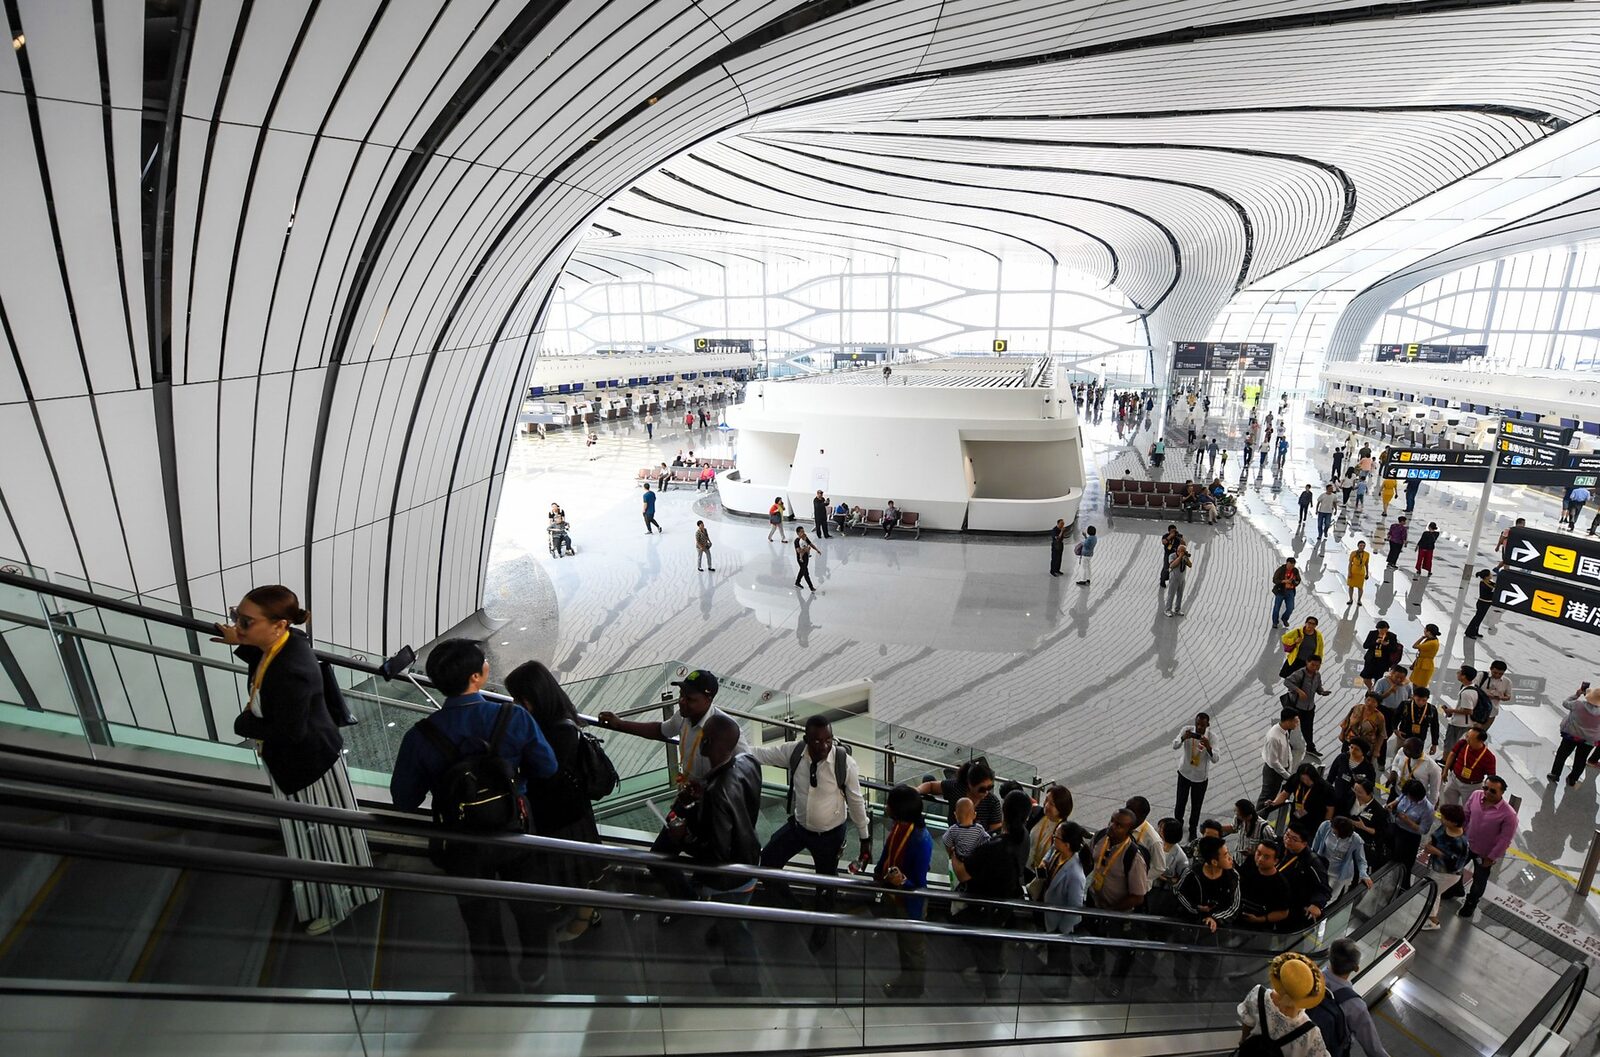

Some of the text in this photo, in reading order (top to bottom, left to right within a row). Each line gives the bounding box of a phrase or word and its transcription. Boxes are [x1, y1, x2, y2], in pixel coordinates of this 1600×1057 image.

[697, 339, 706, 348] C
[995, 340, 1005, 351] D
[1407, 344, 1419, 357] E
[1411, 452, 1447, 463] 国内登机
[1537, 920, 1569, 939] Keep
